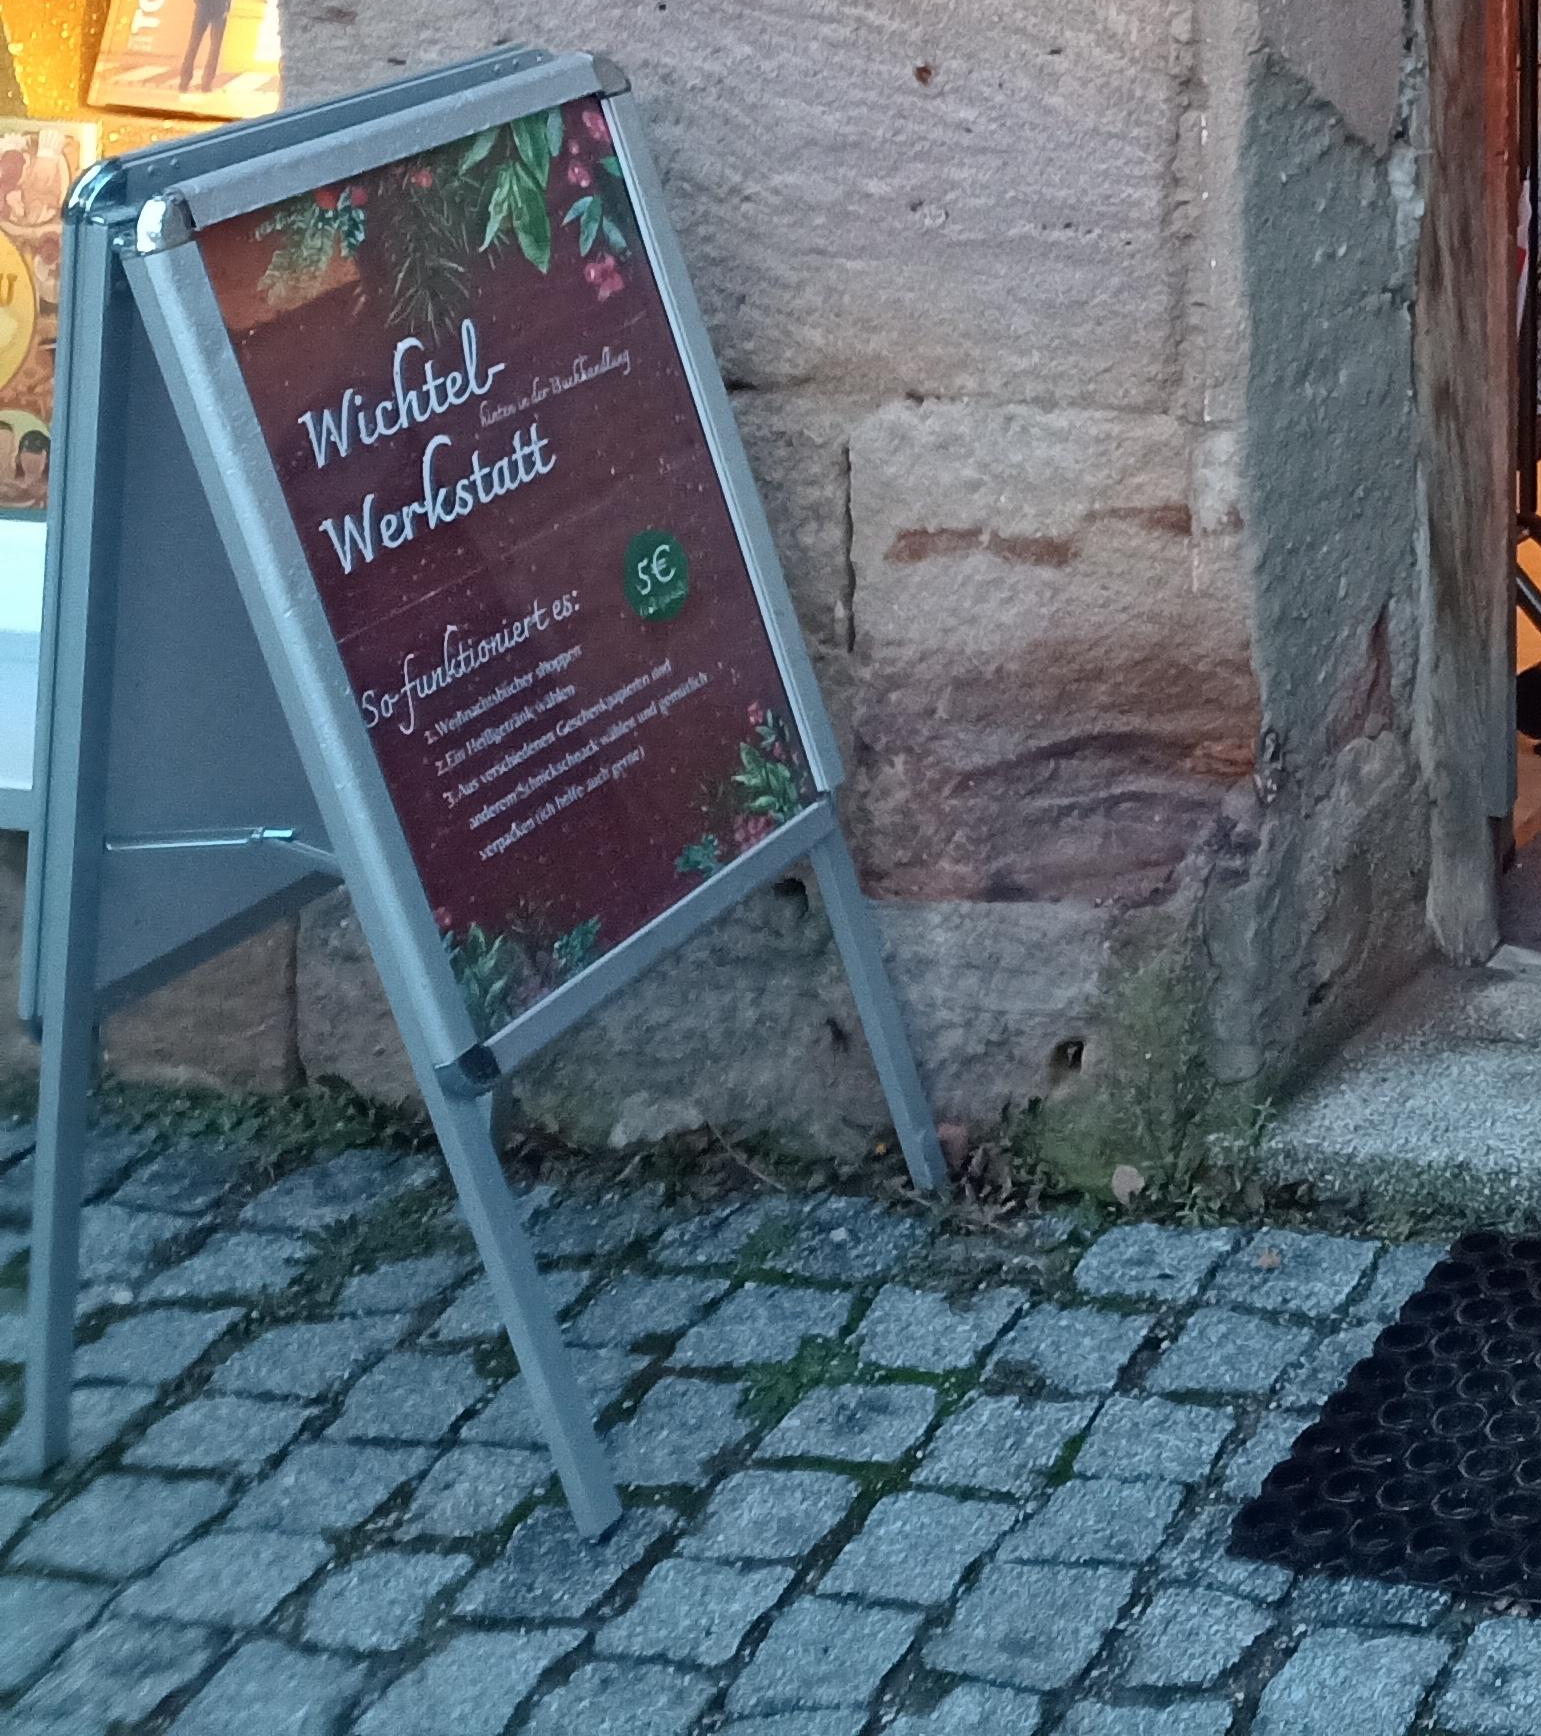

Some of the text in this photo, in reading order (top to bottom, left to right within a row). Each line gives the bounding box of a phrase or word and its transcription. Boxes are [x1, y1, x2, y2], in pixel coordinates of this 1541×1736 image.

[298, 319, 506, 469] Wichtel-
[319, 422, 557, 575] Werkstatt
[636, 544, 676, 596] 5€
[362, 590, 580, 735] So funktioniert es:
